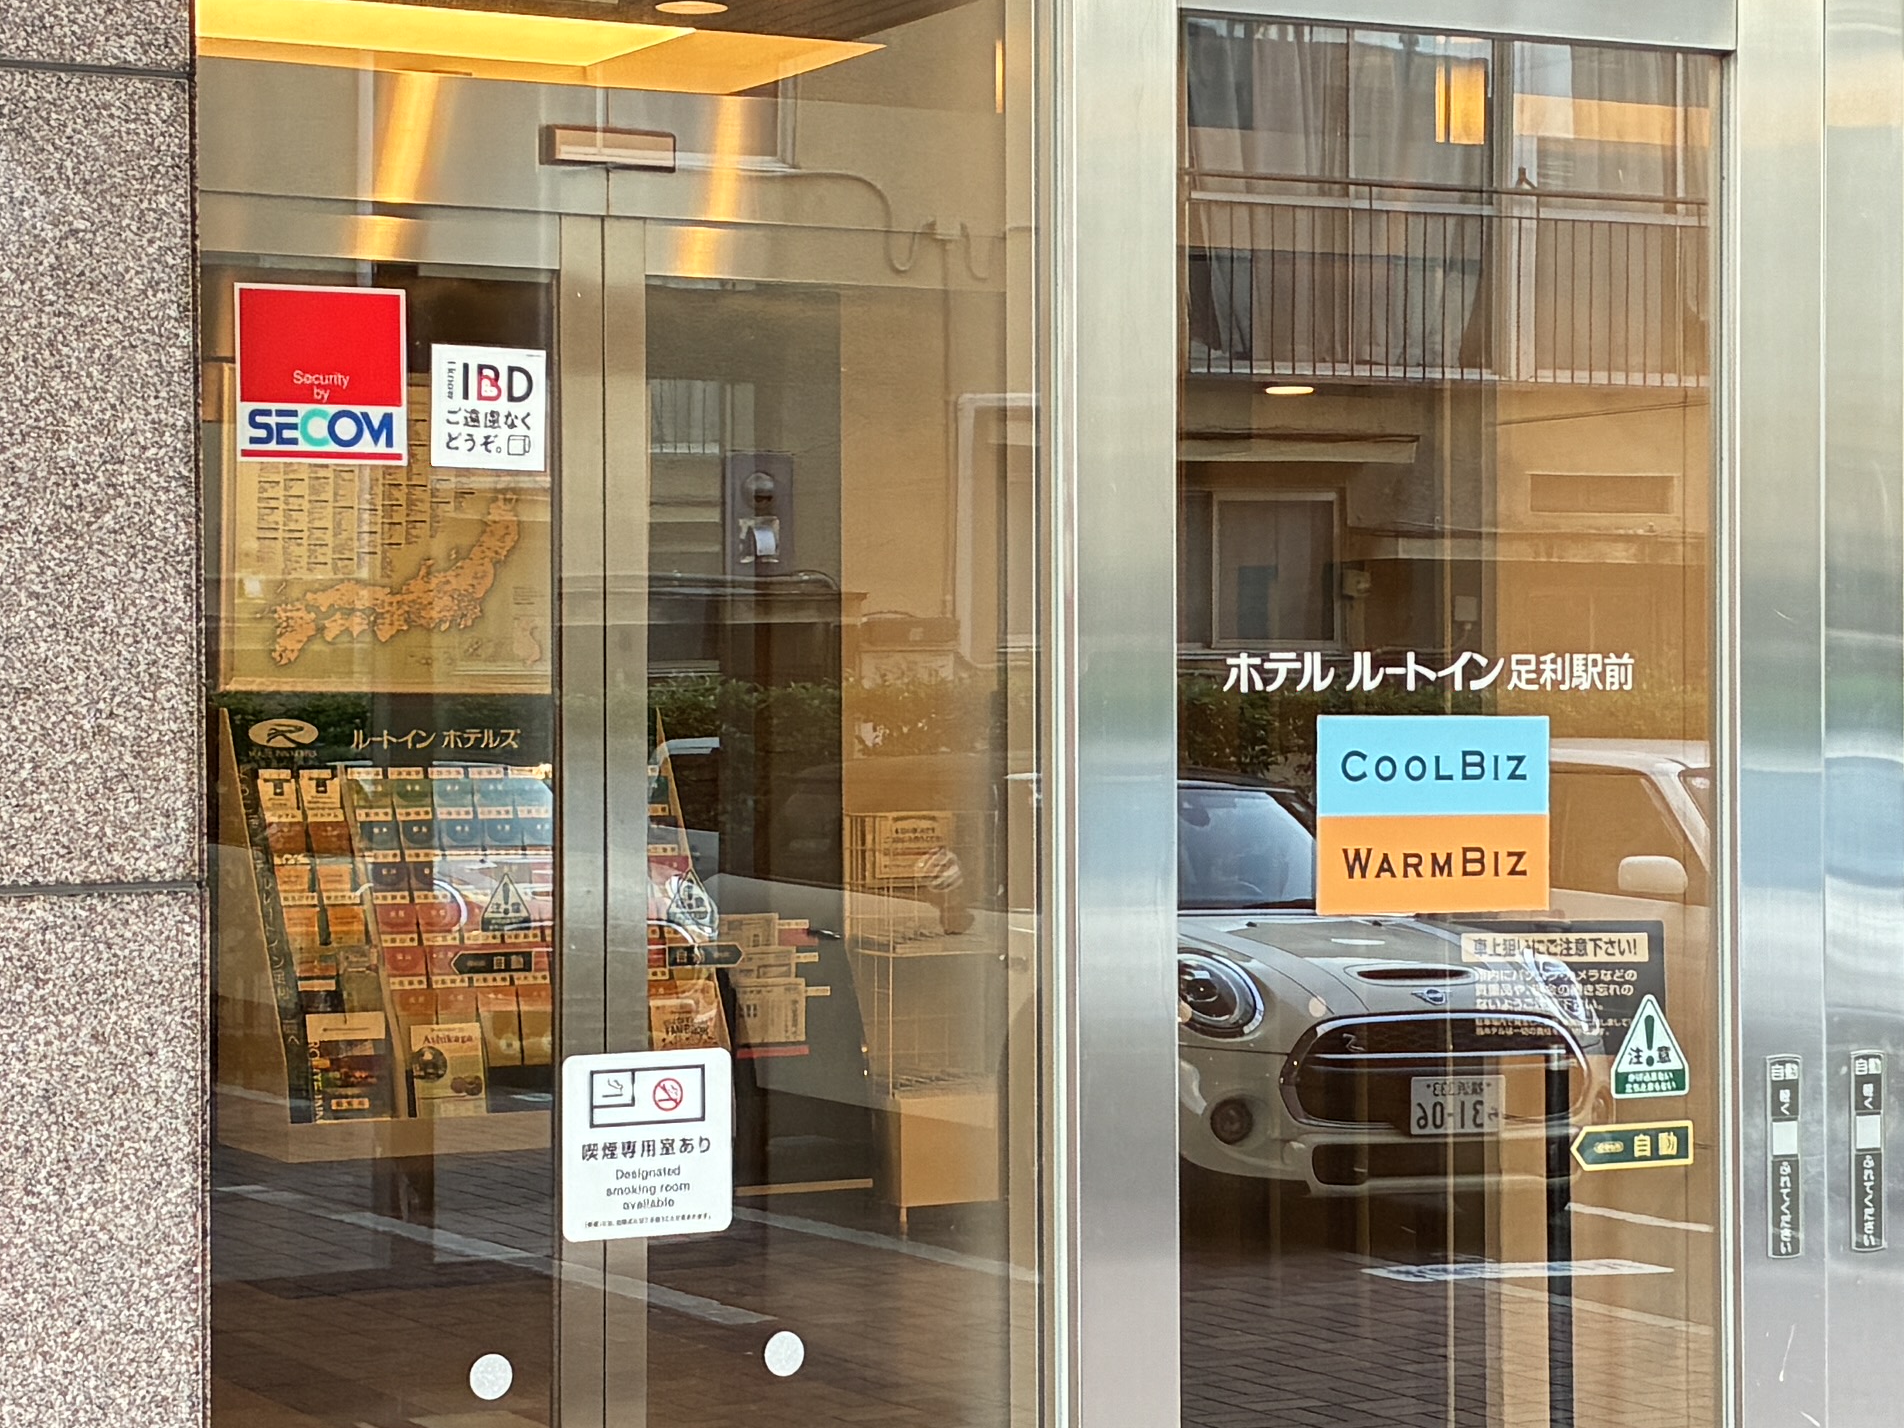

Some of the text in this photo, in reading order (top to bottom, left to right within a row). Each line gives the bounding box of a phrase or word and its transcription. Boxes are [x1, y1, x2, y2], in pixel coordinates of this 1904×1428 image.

[293, 370, 350, 389] Security
[462, 362, 534, 403] IBD
[313, 385, 330, 401] by
[248, 408, 394, 449] SECOM
[446, 407, 531, 431] ご遠慮なく
[446, 432, 502, 453] どうぞ。
[1222, 651, 1636, 693] ホテル ルートイン足利駅前
[351, 728, 522, 750] ルートイン ホテルズ
[1628, 1046, 1671, 1065] 注意
[581, 1135, 711, 1161] 喫煙専用室あり
[1633, 1131, 1678, 1157] 自動
[615, 1164, 681, 1180] Designated
[606, 1182, 690, 1197] smoking room
[622, 1197, 675, 1210] available
